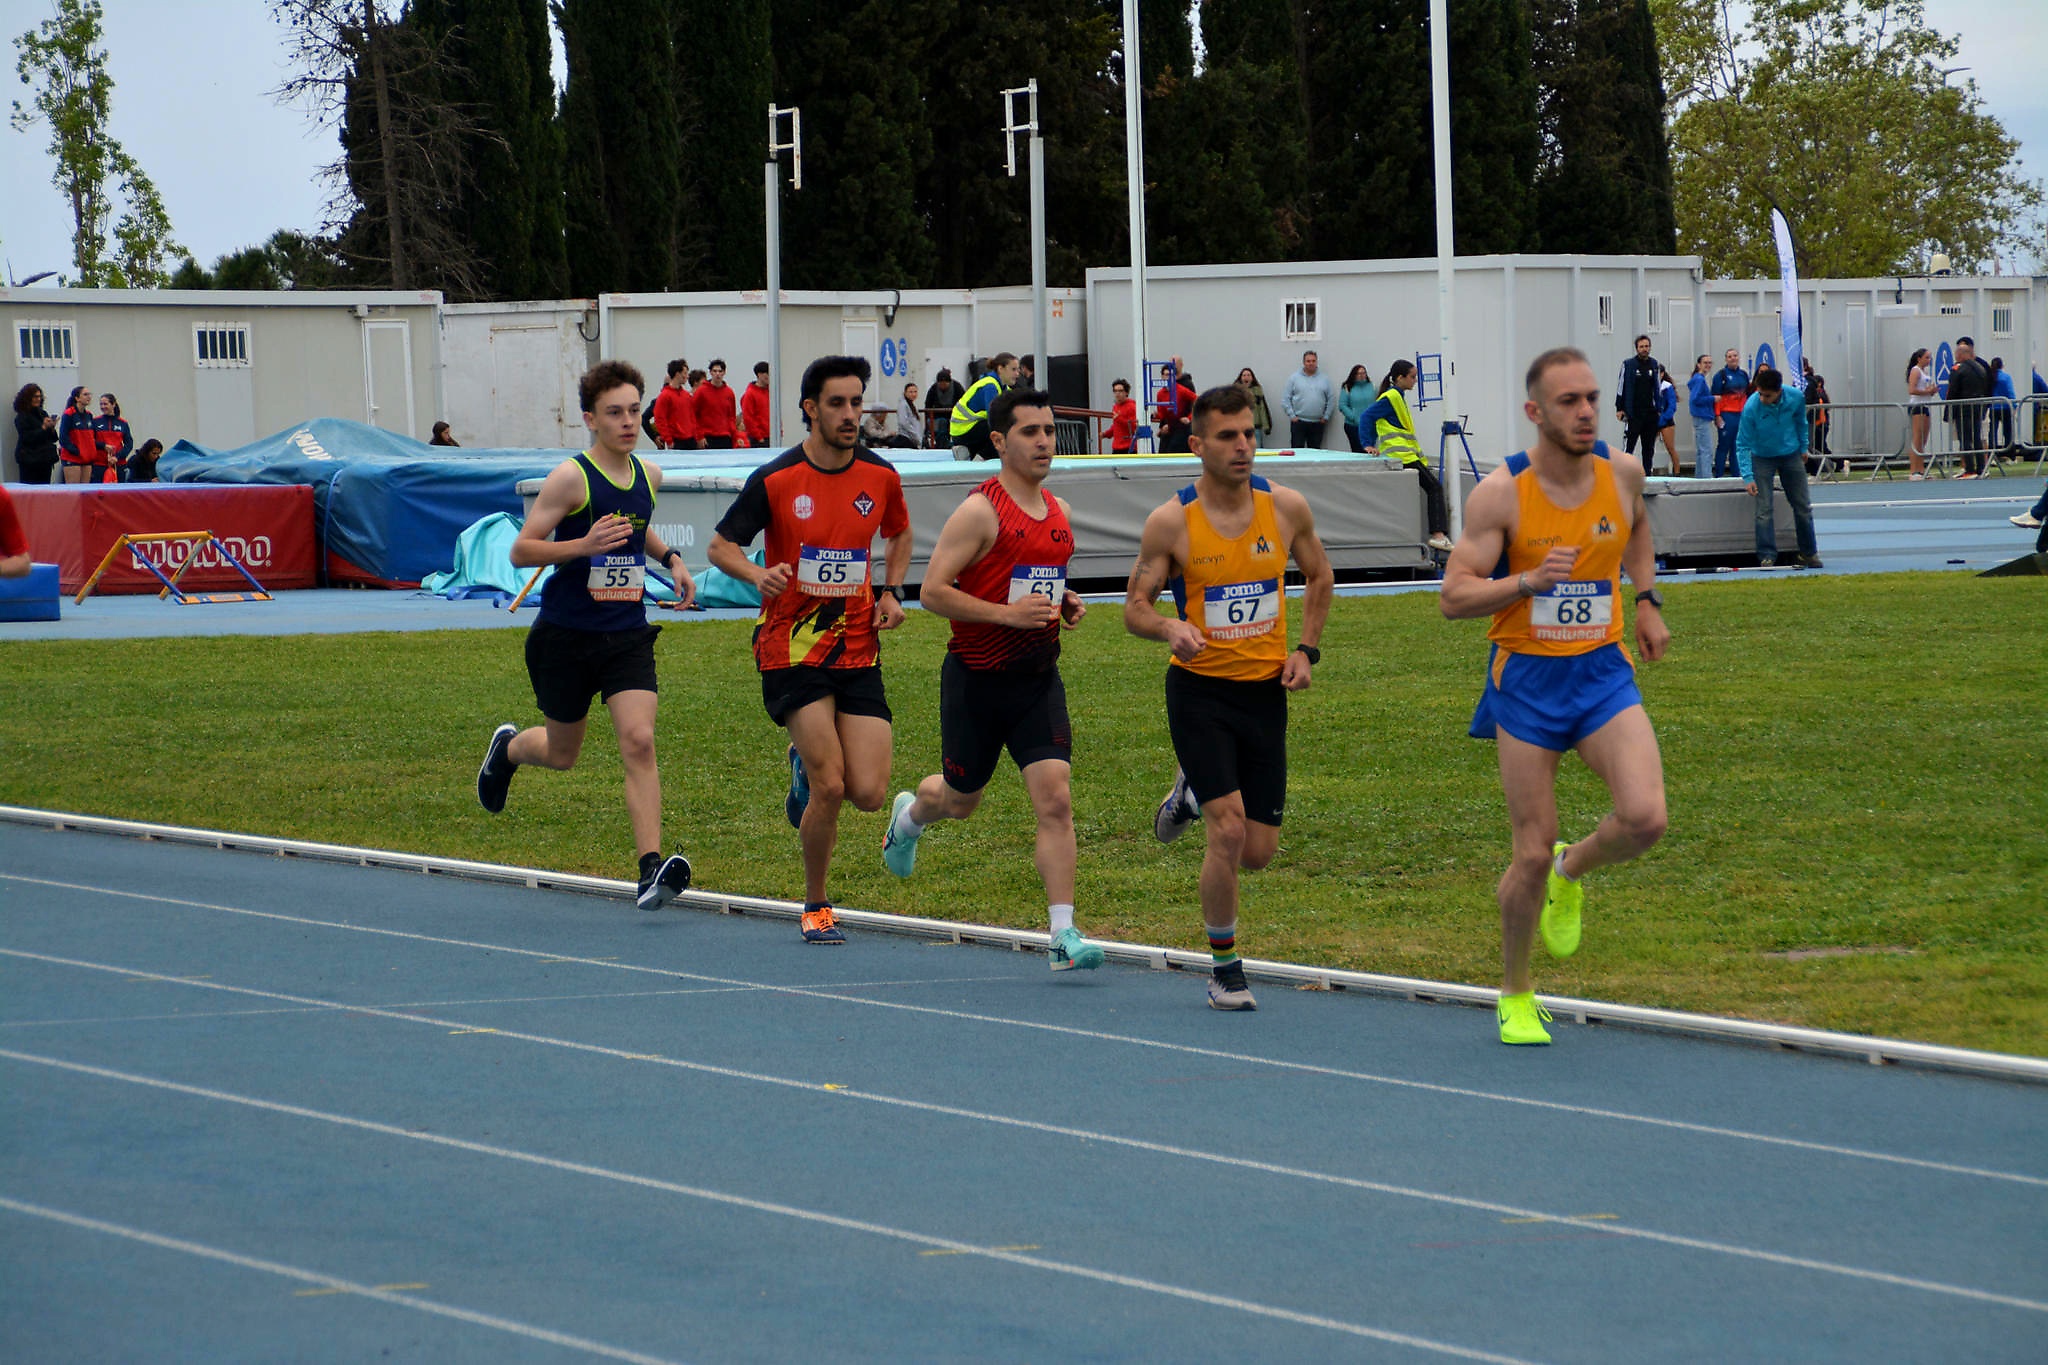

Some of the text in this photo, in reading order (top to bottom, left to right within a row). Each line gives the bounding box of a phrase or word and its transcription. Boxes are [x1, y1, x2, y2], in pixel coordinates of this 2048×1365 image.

[131, 536, 271, 570] MONDO
[604, 568, 630, 587] 55
[817, 563, 847, 583] 65
[801, 582, 858, 597] mutuacat
[1031, 581, 1054, 601] 63
[1227, 598, 1260, 624] 67
[1557, 599, 1592, 624] 68
[1211, 620, 1276, 640] mutuacat
[1536, 626, 1607, 640] mutuacat
